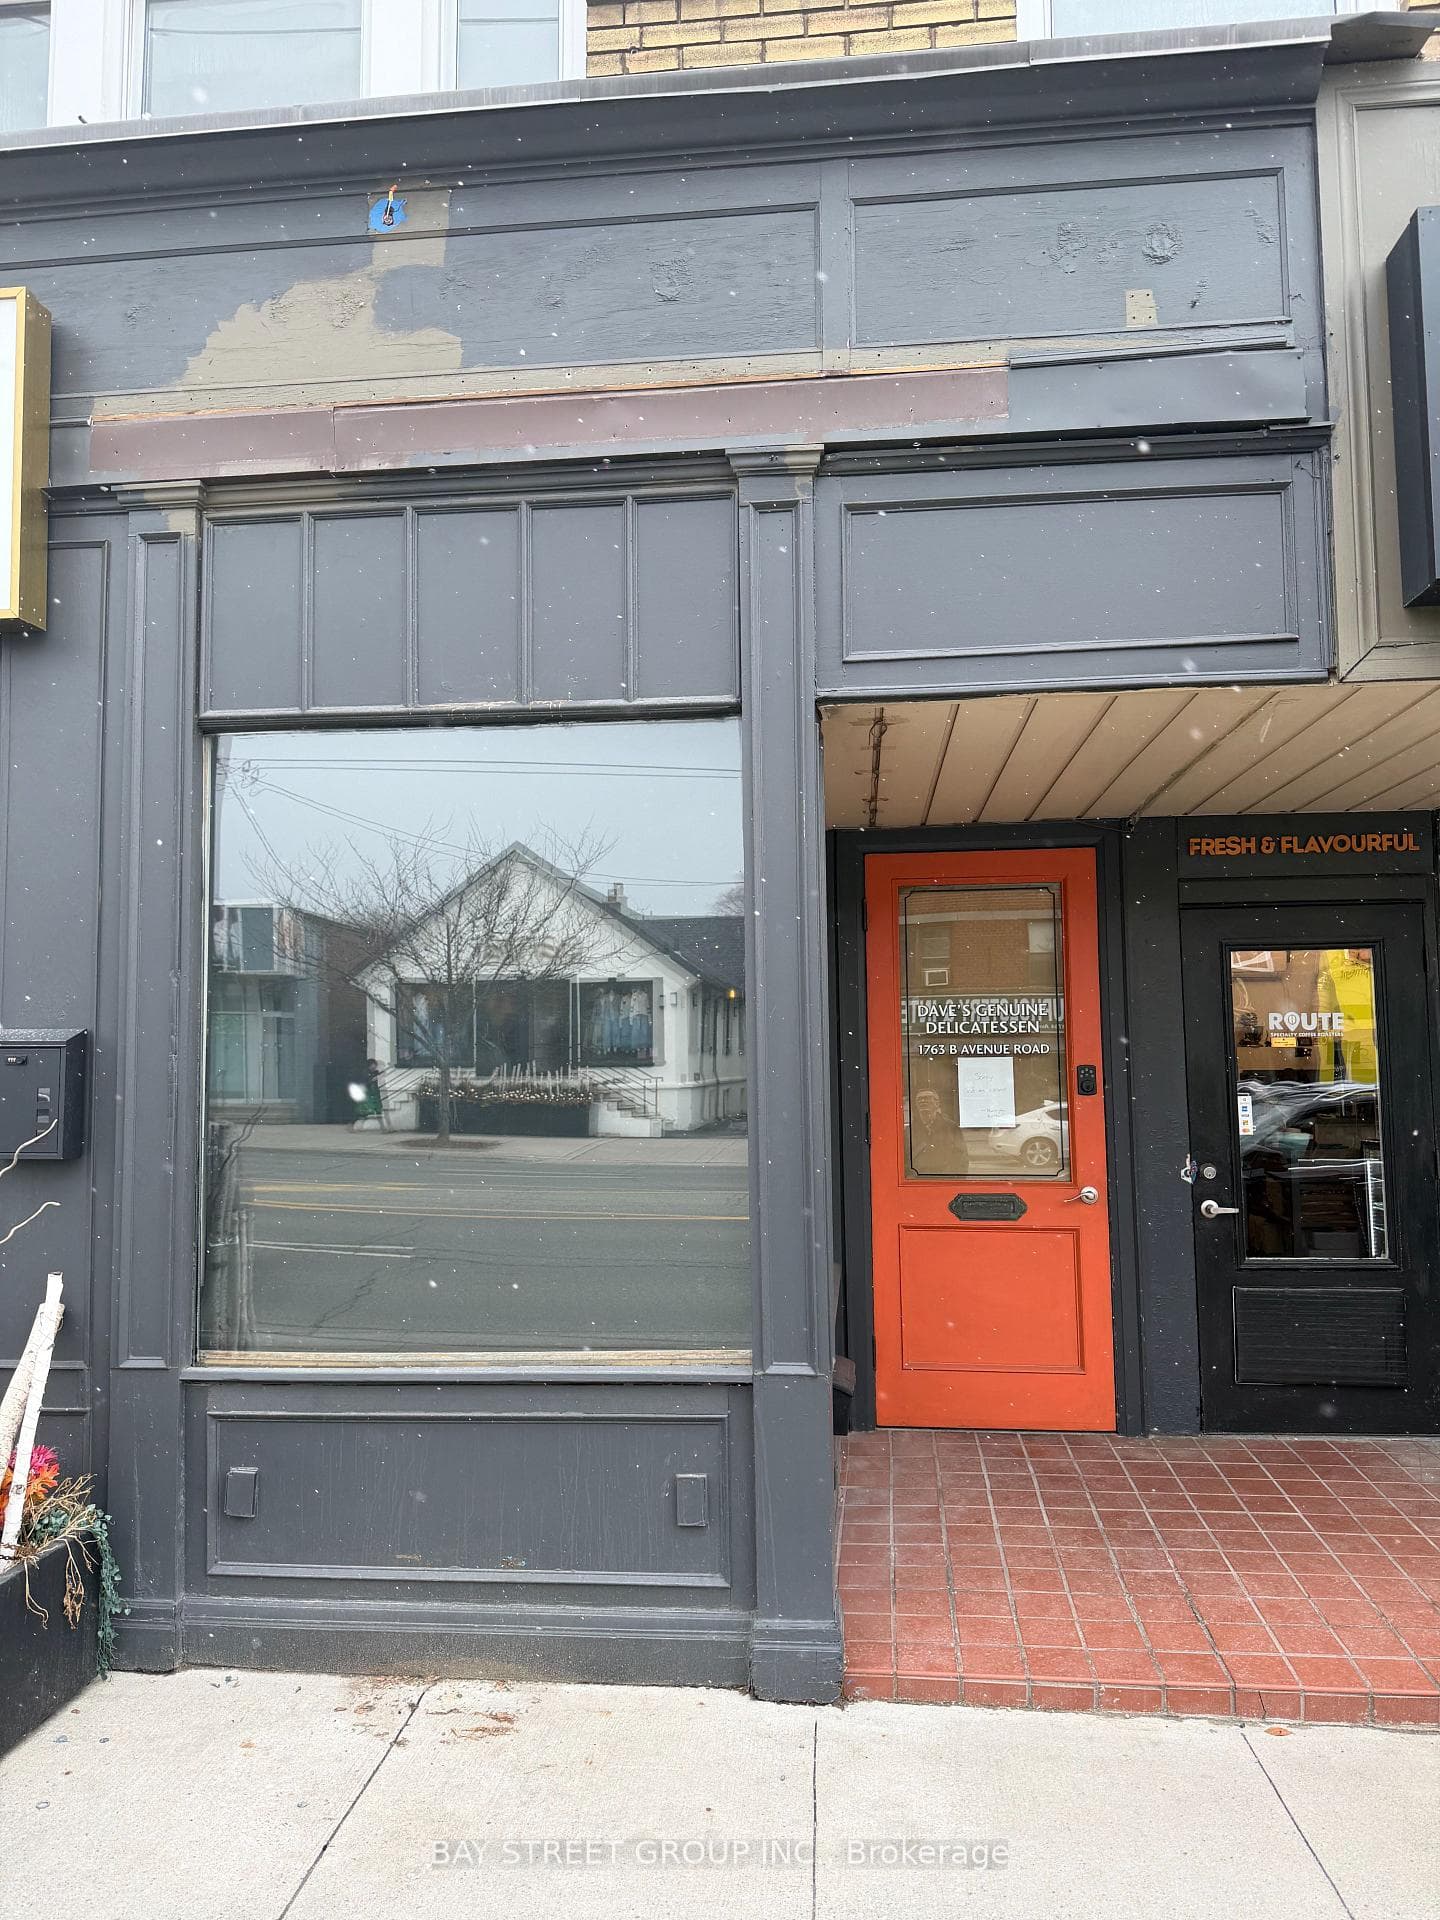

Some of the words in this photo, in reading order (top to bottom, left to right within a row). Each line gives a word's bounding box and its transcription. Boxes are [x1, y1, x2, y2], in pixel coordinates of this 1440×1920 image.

[1189, 836, 1256, 856] FRESH
[1260, 836, 1276, 854] &
[1280, 833, 1421, 854] FLAVOURFUL
[917, 1004, 971, 1017] DAVE'S
[976, 1003, 1048, 1017] GENUINE
[926, 1021, 1041, 1034] DELICATESSEN
[1268, 1011, 1345, 1032] ROUTE
[918, 1044, 945, 1055] 1763
[949, 1044, 957, 1054] B
[960, 1043, 1010, 1055] AVENUE
[1013, 1043, 1050, 1054] ROAD
